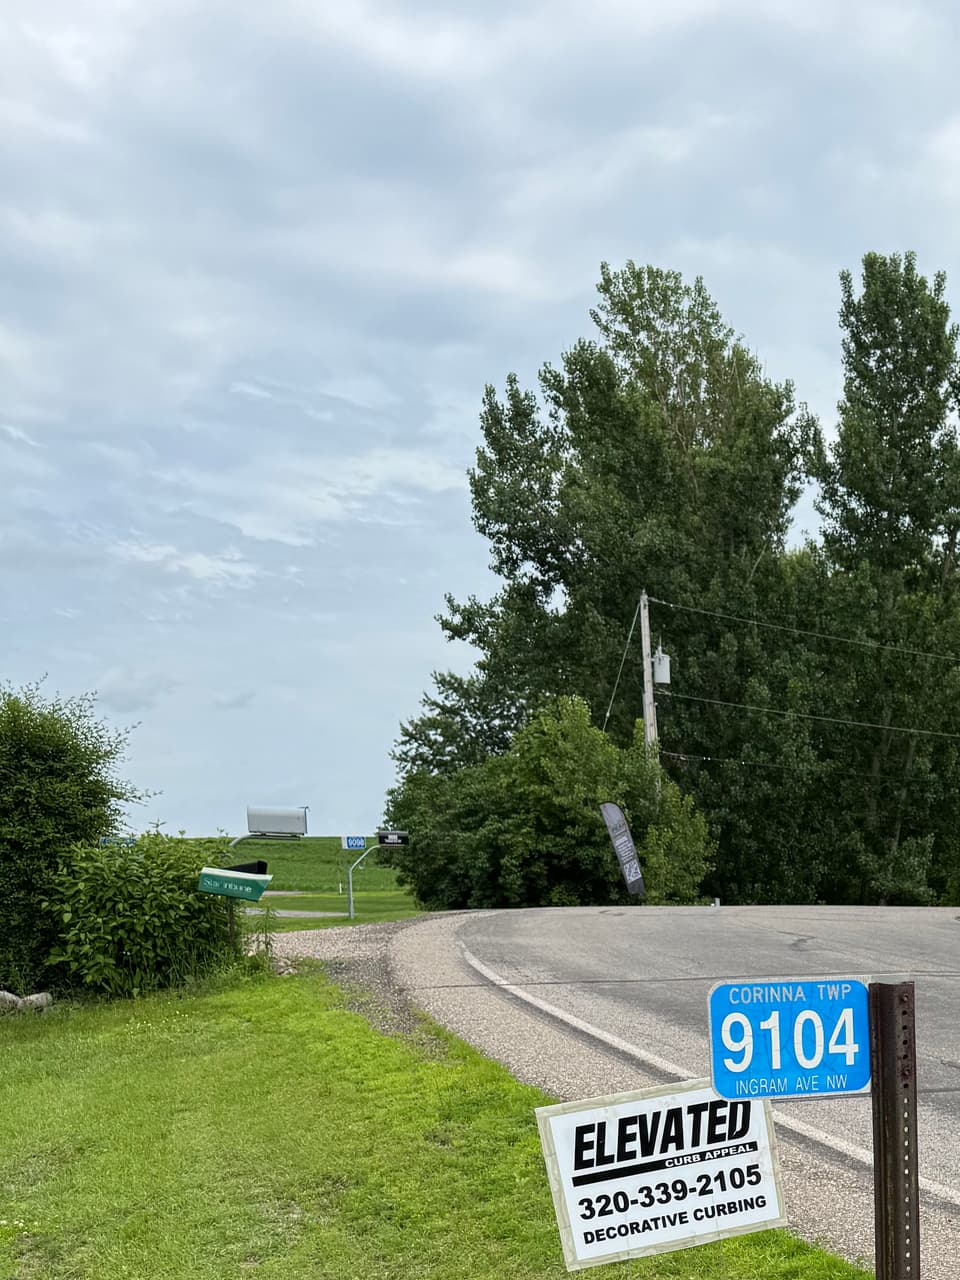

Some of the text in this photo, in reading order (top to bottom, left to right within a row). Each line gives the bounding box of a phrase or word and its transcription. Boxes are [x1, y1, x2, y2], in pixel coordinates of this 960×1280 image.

[729, 984, 852, 1005] CORINNA TWP
[721, 1007, 859, 1073] 9104
[735, 1074, 848, 1095] INGRAM AVE NW
[574, 1100, 752, 1171] ELEVATED
[665, 1144, 753, 1168] CURB APPEAL
[578, 1164, 762, 1220] 320-339-2105
[583, 1195, 767, 1244] DECORATIVE CURBING
